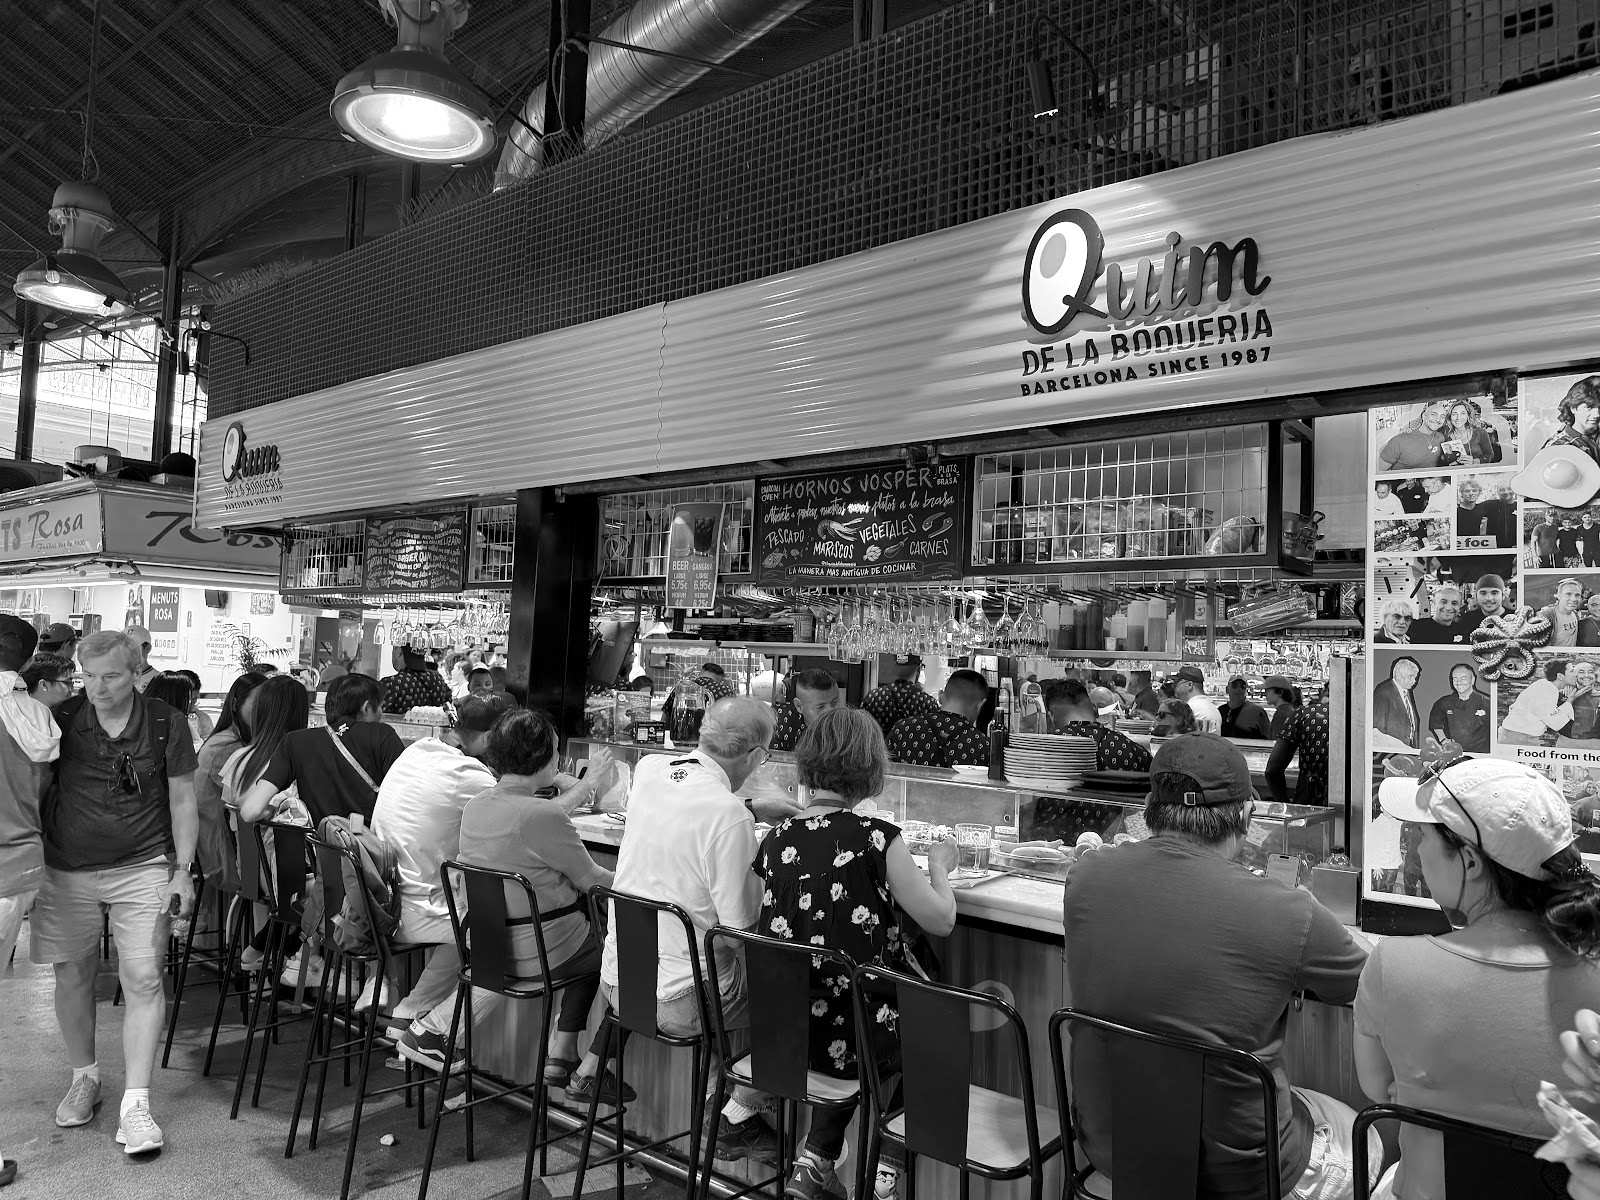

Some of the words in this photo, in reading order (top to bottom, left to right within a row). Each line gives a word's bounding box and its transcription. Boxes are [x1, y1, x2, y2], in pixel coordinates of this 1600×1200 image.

[1022, 208, 1272, 335] Quim
[1022, 346, 1055, 377] DE
[1066, 339, 1100, 369] LA
[1111, 309, 1273, 362] BOQUERIA
[1021, 366, 1138, 396] BARCELONA
[1148, 355, 1210, 377] SINCE
[1221, 346, 1271, 366] 1987
[938, 464, 957, 474] PLATS
[937, 477, 958, 485] BRASA
[783, 477, 854, 499] HORNOS
[761, 493, 780, 502] OVEN
[871, 492, 896, 517] platos
[900, 501, 906, 509] a
[909, 490, 920, 509] la
[922, 490, 955, 509] brasa
[28, 510, 83, 548] Rosa
[859, 514, 916, 543] VEGETALES
[765, 528, 804, 549] PESCADO
[1464, 538, 1489, 547] foc
[909, 538, 949, 557] CARNES
[672, 560, 690, 570] BEER
[788, 567, 797, 575] LA
[798, 567, 825, 576] MANERA
[826, 568, 839, 576] MAS
[871, 567, 880, 575] DE
[883, 562, 917, 575] COCINAR
[671, 580, 688, 591] 5,75€
[694, 580, 711, 591] 6,95€
[151, 592, 179, 604] MENUTS
[155, 608, 173, 620] ROSA
[1517, 749, 1545, 758] Food
[1550, 750, 1578, 760] from
